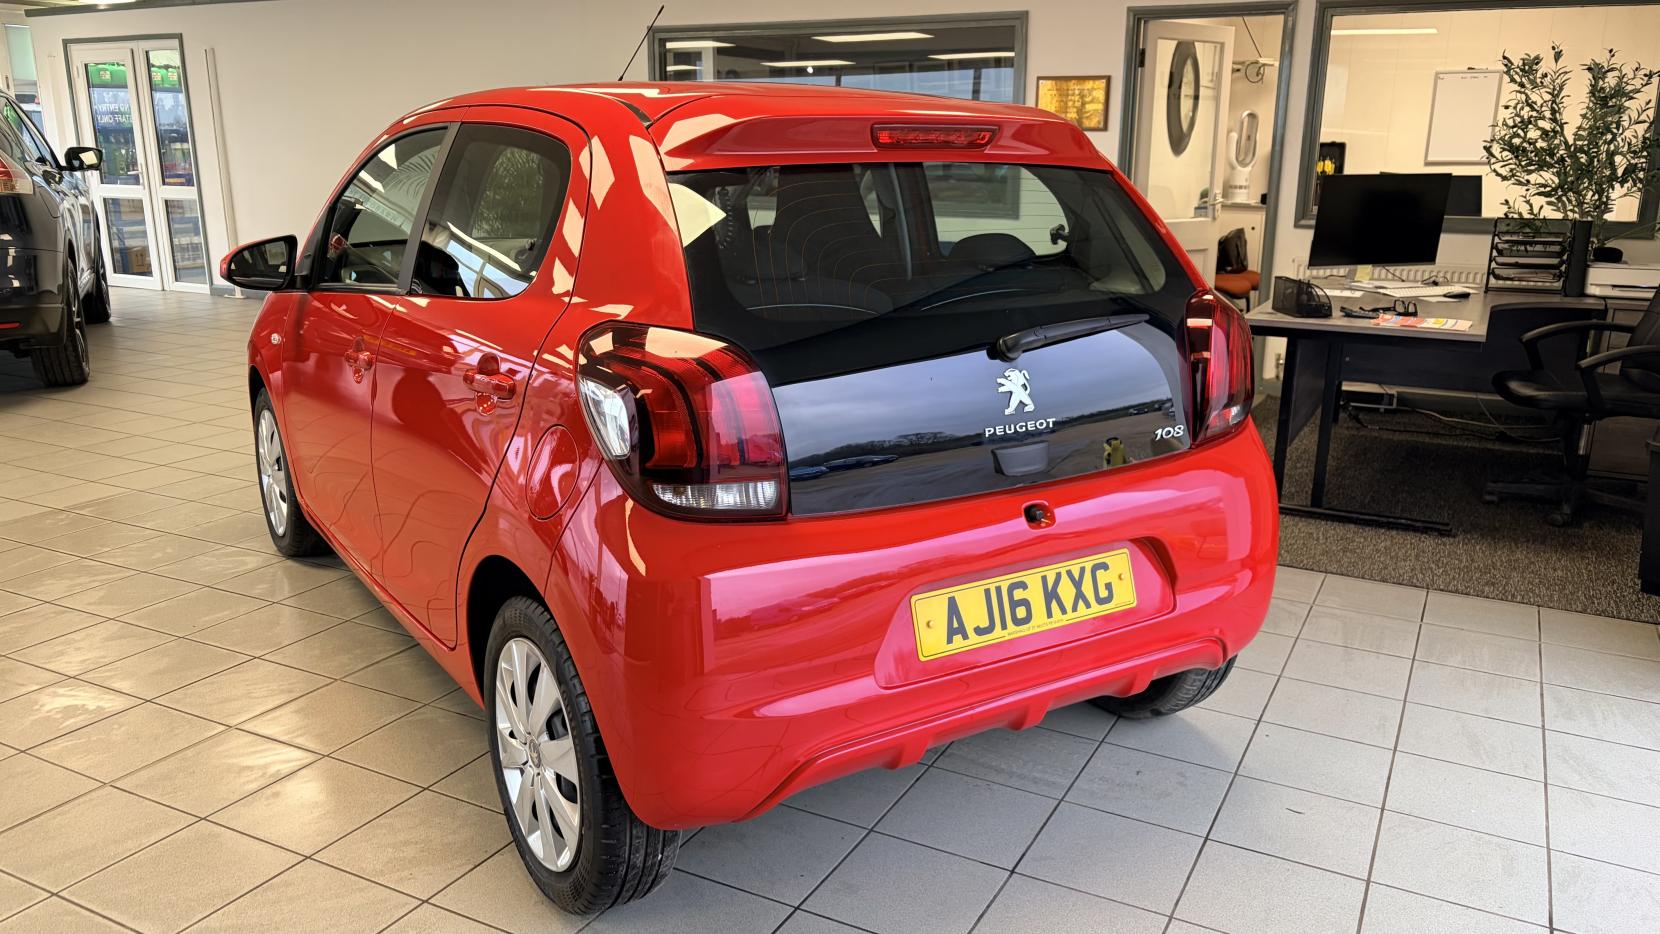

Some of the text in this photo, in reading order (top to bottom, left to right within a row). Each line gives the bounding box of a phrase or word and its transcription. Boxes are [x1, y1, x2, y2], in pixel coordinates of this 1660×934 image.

[985, 418, 1056, 438] PEUGEOT
[1154, 425, 1184, 441] 108
[946, 561, 1113, 645] AJ16 KXG
